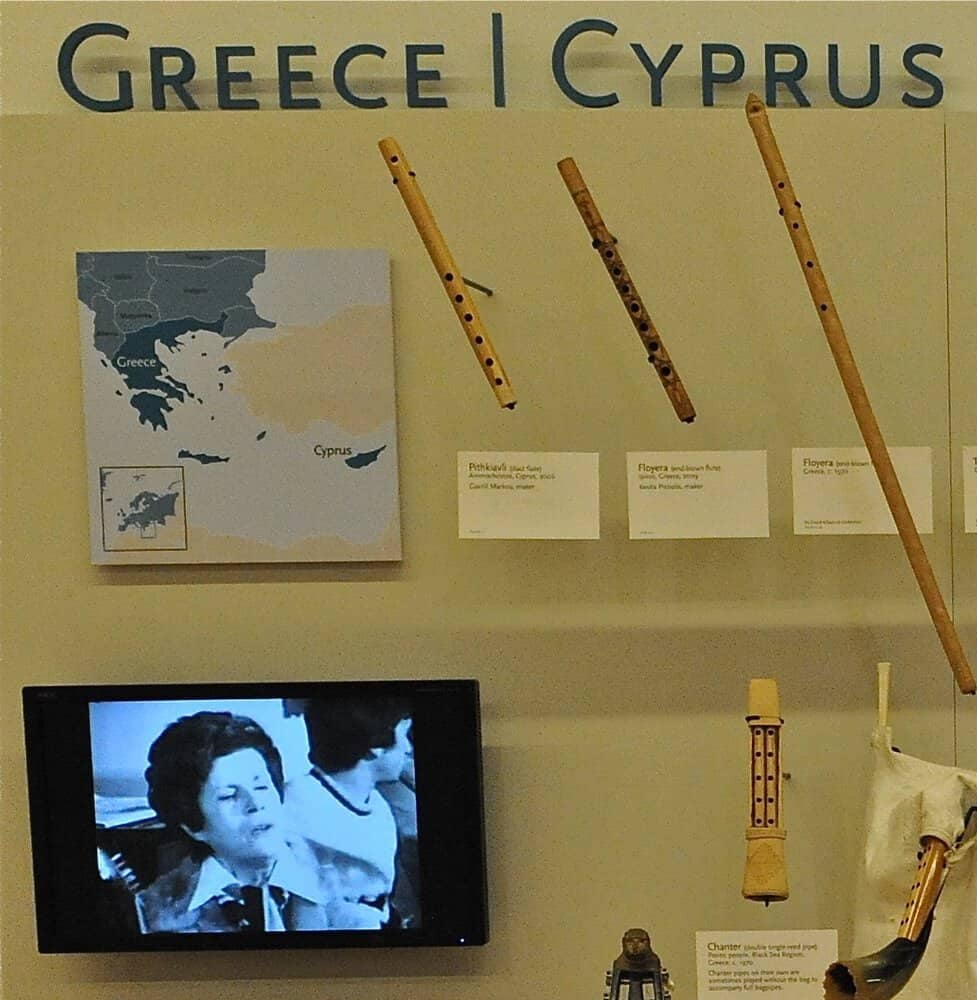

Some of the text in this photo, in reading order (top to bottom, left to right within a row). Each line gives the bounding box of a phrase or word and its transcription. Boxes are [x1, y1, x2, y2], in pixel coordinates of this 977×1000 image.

[116, 356, 157, 367] Greece
[314, 445, 352, 459] Cyprus
[803, 458, 833, 468] Floyera
[638, 464, 668, 473] Floyera
[707, 942, 741, 950] Chanter
